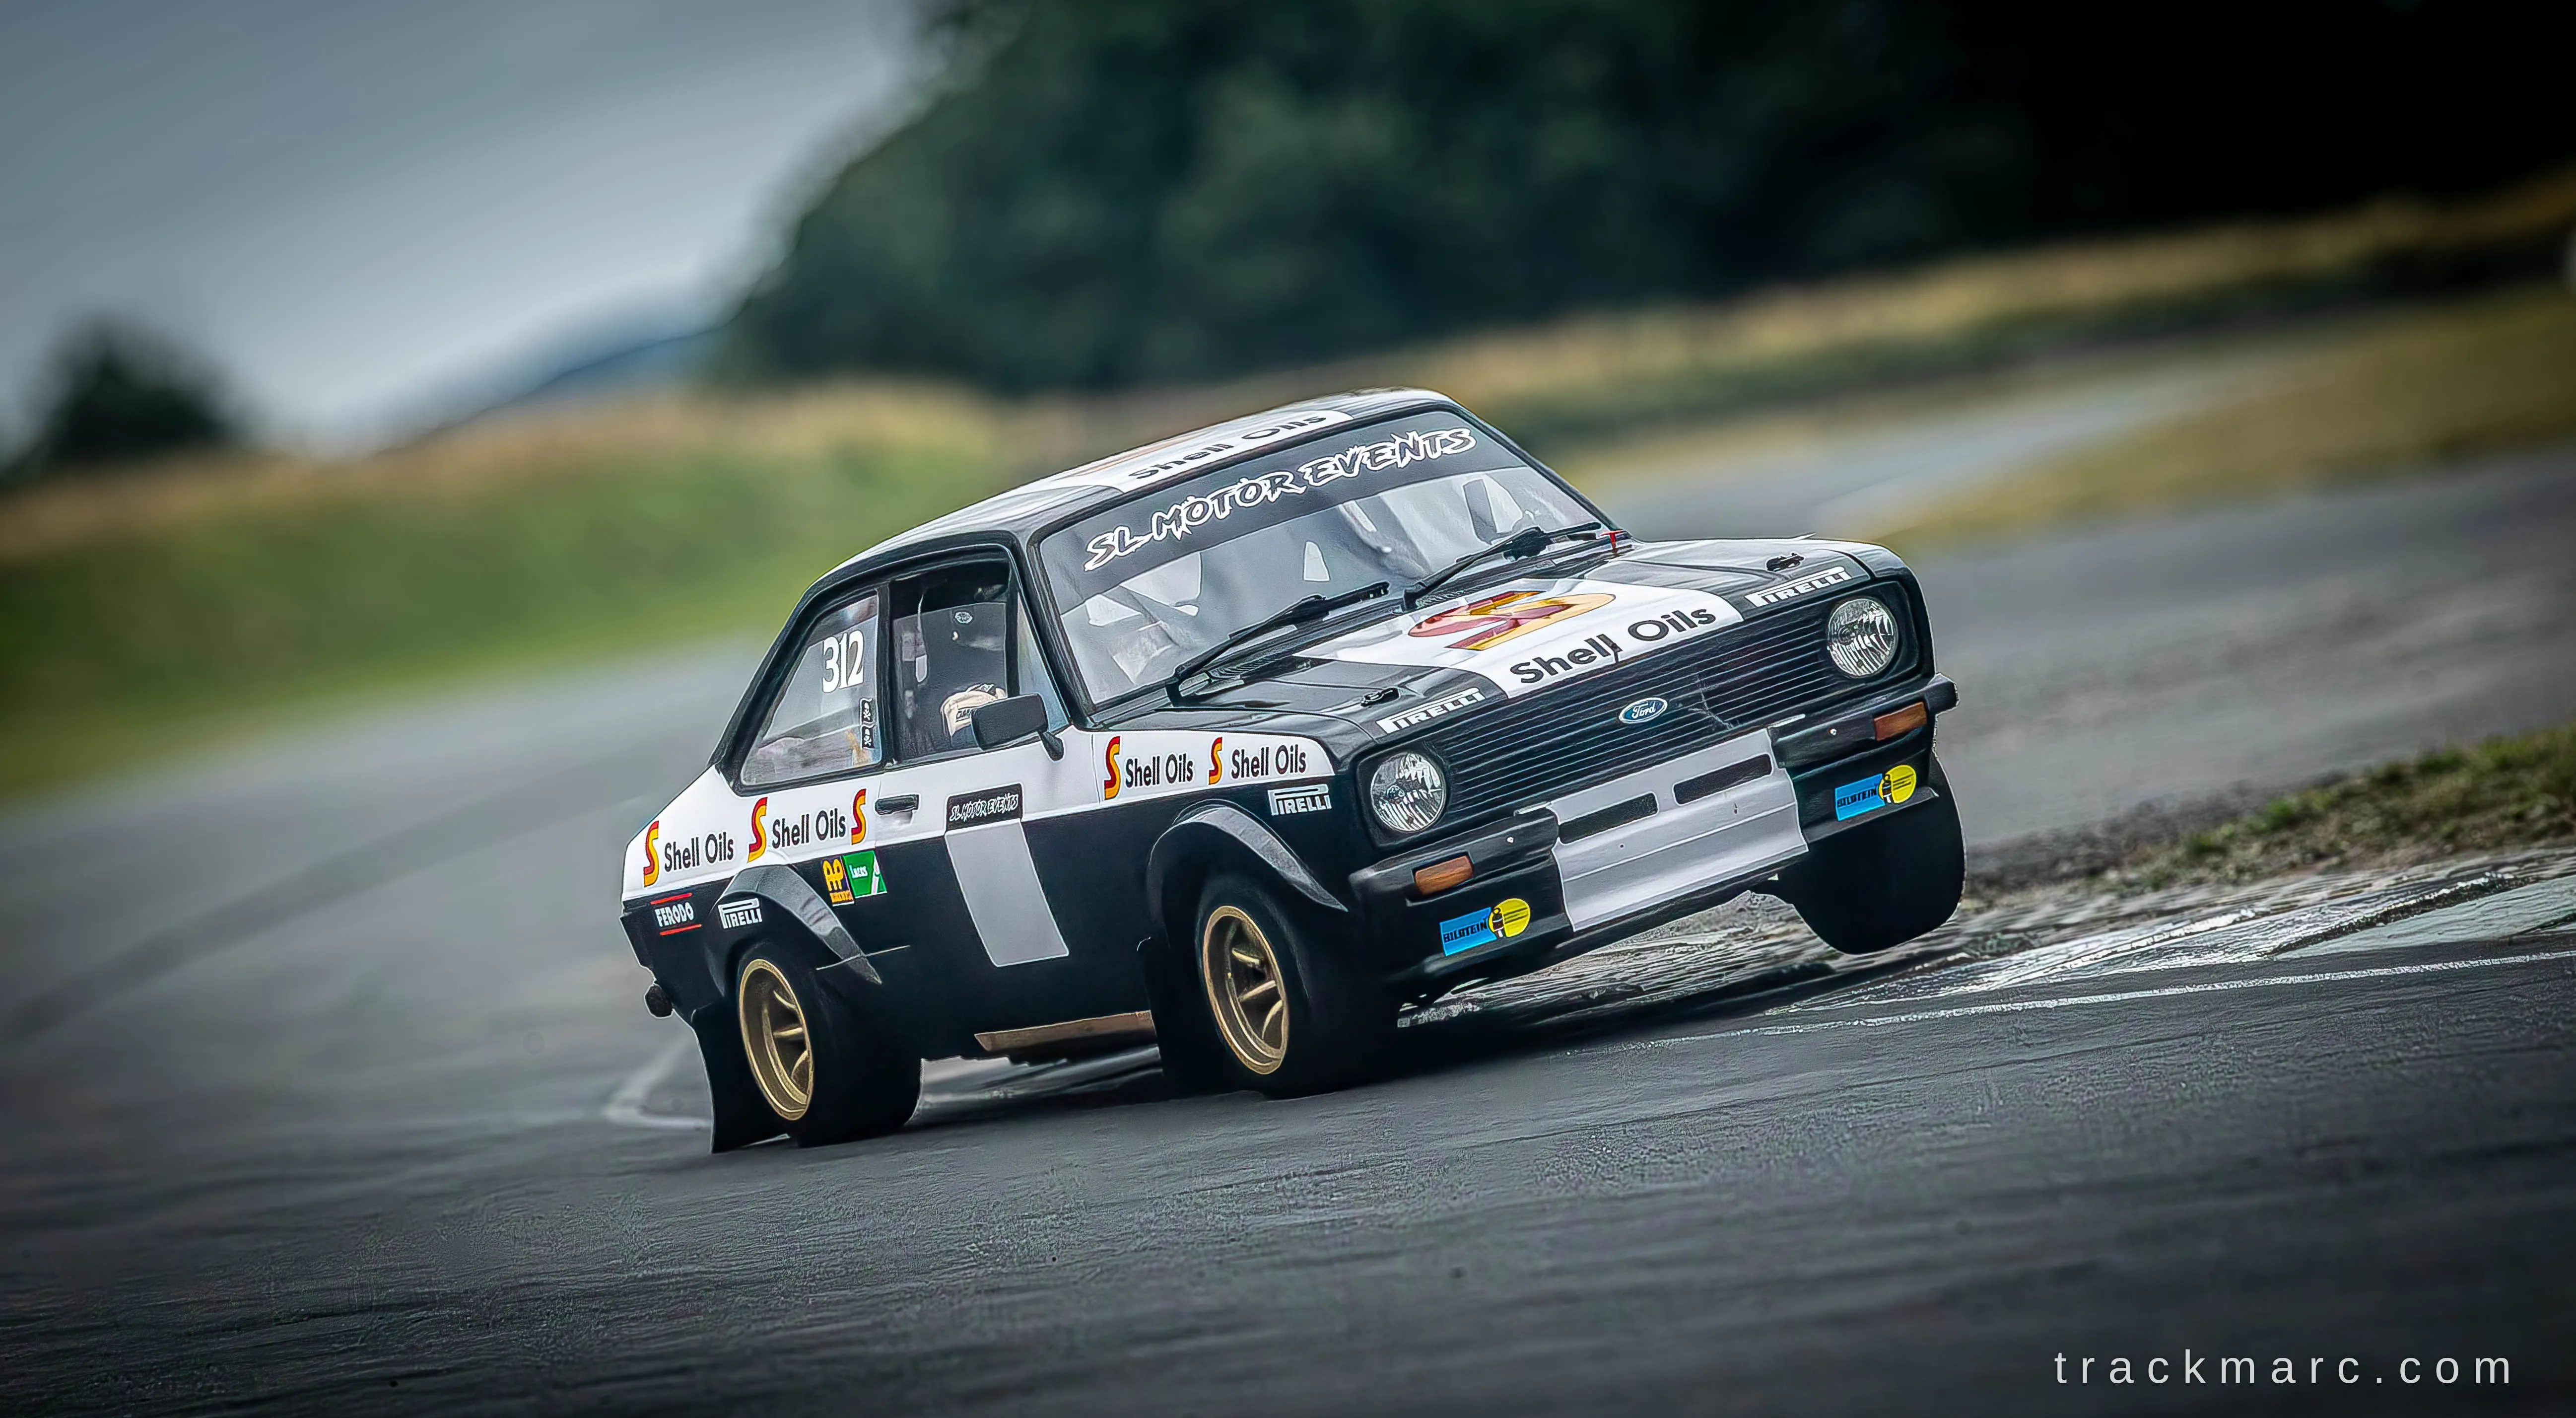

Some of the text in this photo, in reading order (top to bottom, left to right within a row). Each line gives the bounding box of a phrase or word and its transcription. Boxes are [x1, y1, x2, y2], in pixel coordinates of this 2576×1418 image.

[1128, 416, 1327, 479] Shell Oils
[1084, 427, 1477, 572] SL MOTOR EVENTS
[1743, 567, 1857, 607] PIRELLI
[822, 630, 864, 693] 312
[1510, 605, 1717, 685] Shell Oils
[1375, 688, 1486, 735] PIRELLI
[1631, 701, 1656, 718] Ford
[1125, 756, 1160, 787] Shell
[1165, 753, 1193, 783] Oils
[1231, 747, 1269, 779] Shell
[1275, 744, 1306, 775] Oils
[949, 792, 1019, 822] SL MOTOR EVENTS
[1268, 783, 1332, 815] PIRELLI
[772, 813, 810, 849] Shell
[815, 808, 846, 841] Oils
[664, 837, 700, 872] Shell
[705, 832, 734, 863] Oils
[654, 902, 694, 927] FERODO
[718, 898, 762, 929] PIRELLI
[1442, 918, 1489, 943] BILSTEIN
